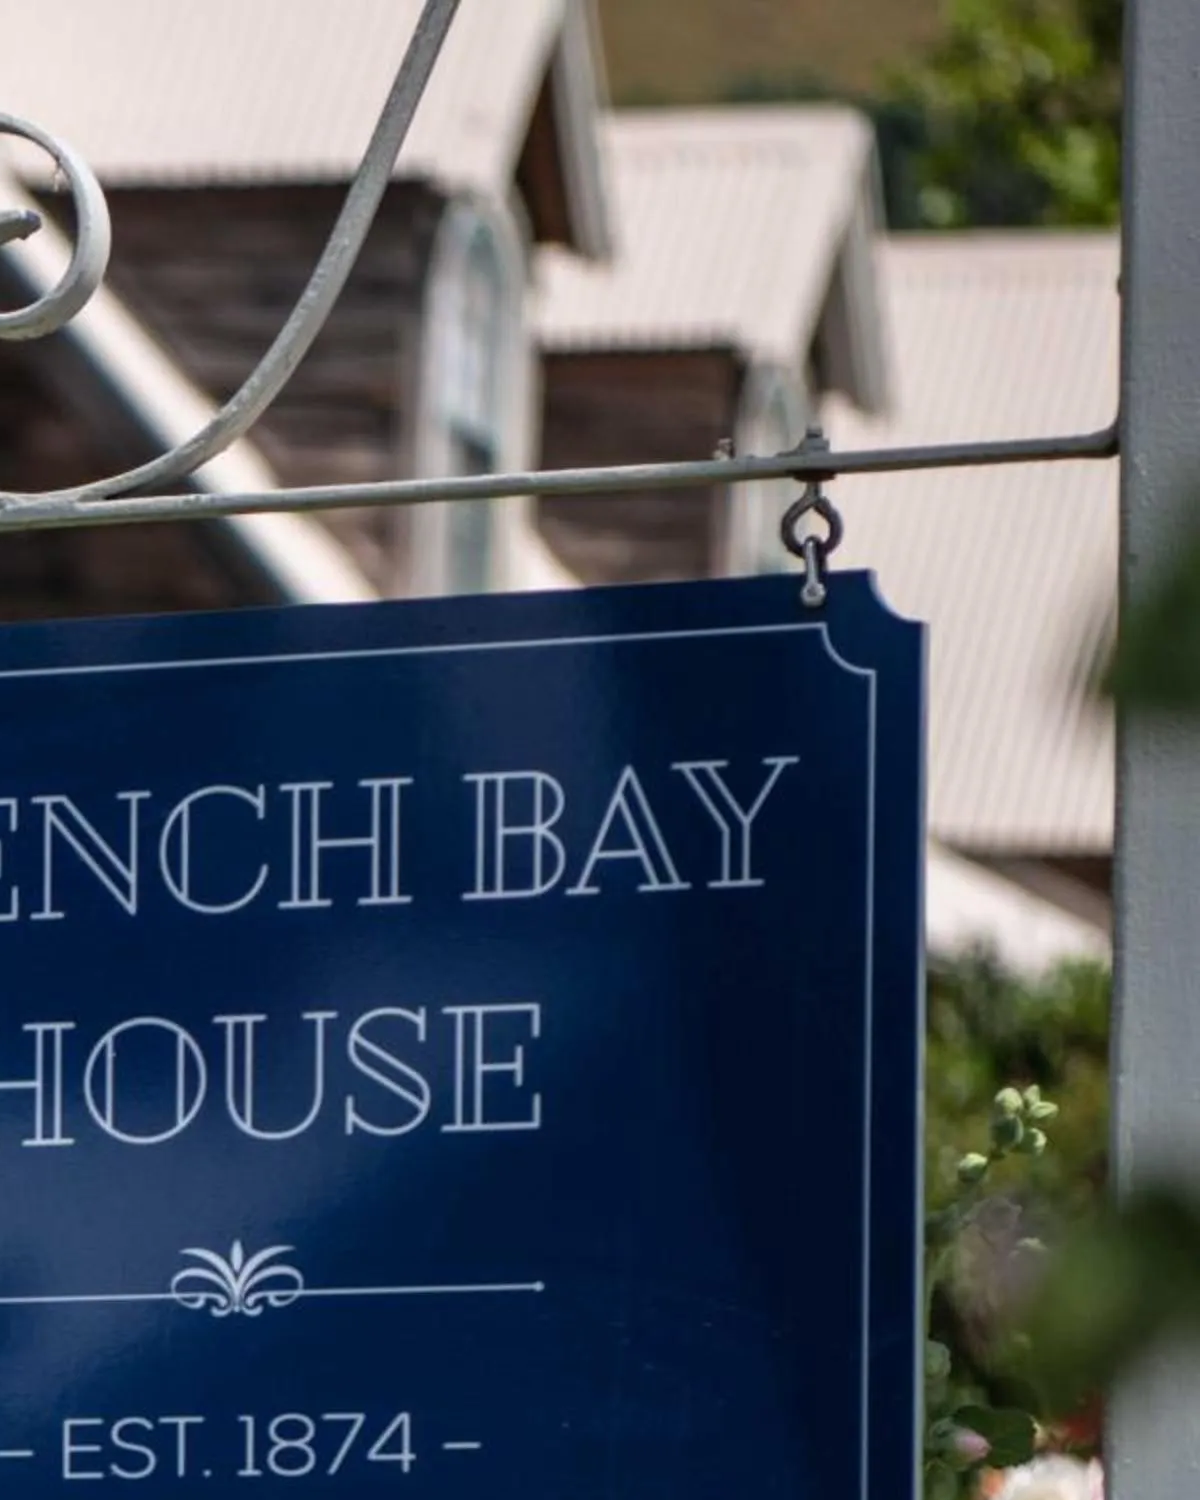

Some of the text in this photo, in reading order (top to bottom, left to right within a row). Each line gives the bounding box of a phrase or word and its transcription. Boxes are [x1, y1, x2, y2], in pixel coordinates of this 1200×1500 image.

[462, 755, 799, 902] BAY
[61, 1416, 211, 1480] EST.
[237, 1411, 416, 1478] 1874
